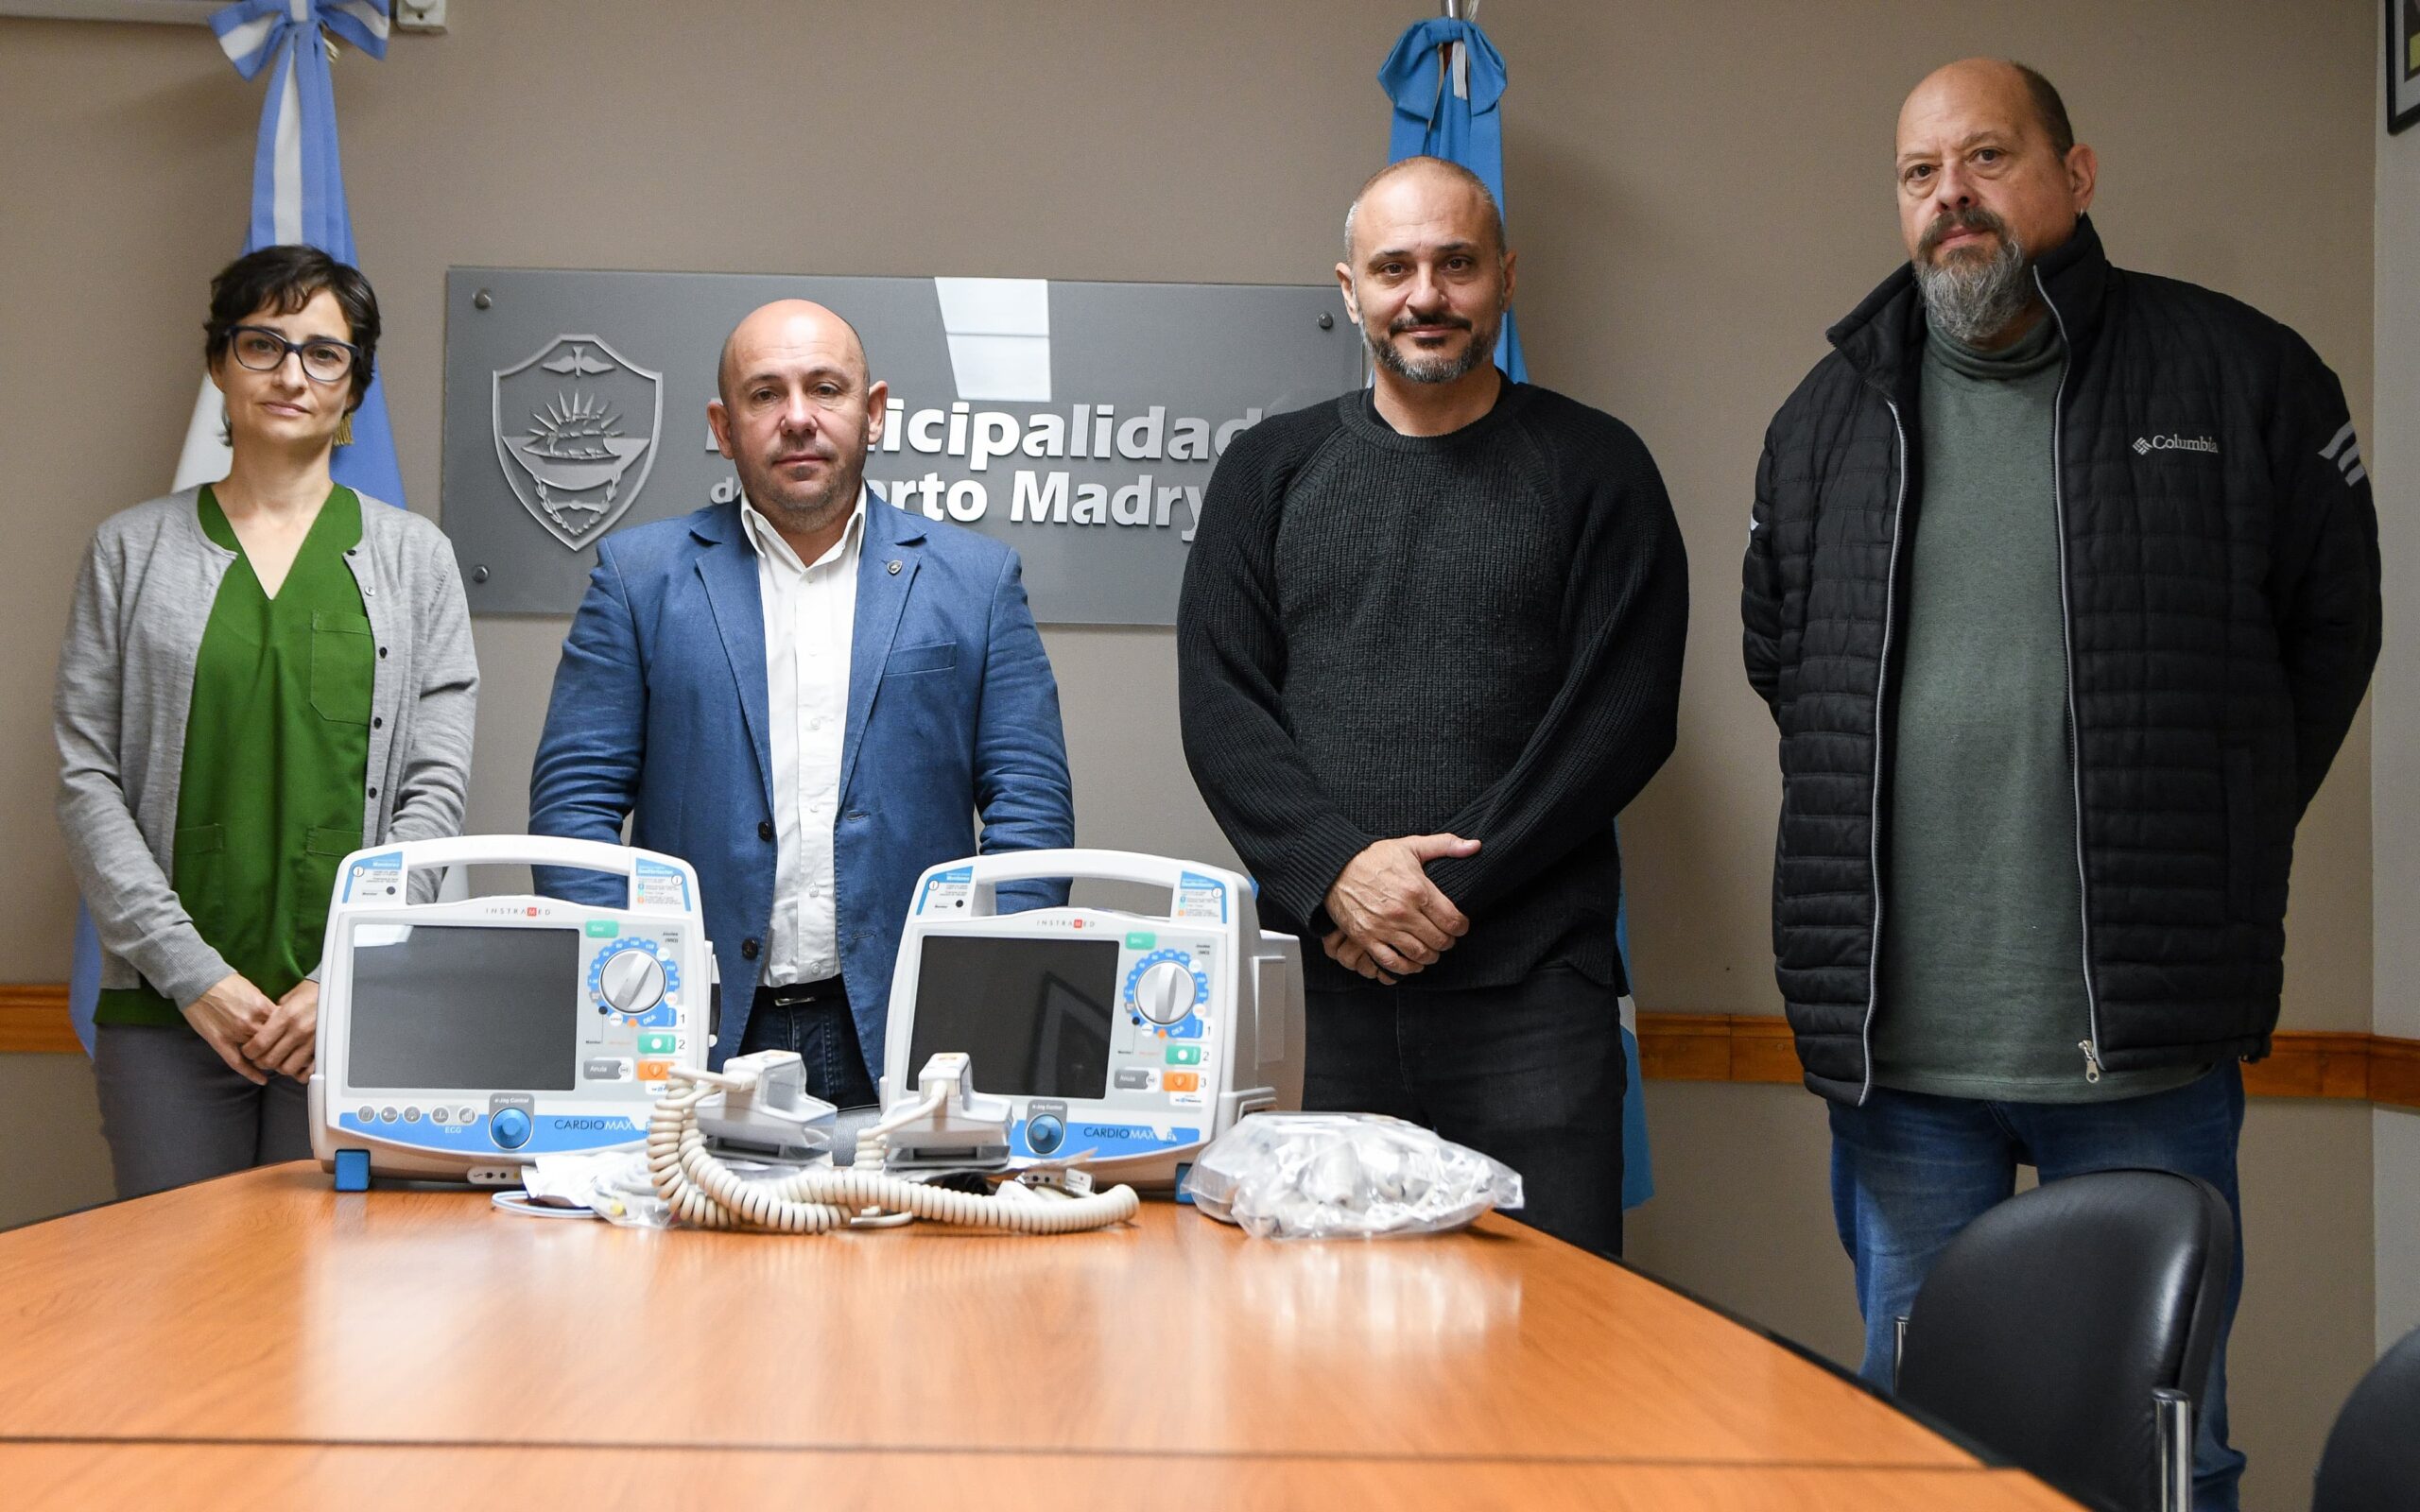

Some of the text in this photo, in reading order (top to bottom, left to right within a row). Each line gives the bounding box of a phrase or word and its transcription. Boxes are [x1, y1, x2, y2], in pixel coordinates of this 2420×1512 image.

[705, 398, 1263, 472] icipalidad
[2152, 434, 2219, 453] Columbia
[710, 470, 1203, 542] d rto Madry
[486, 907, 551, 917] INSTRAMED
[680, 1013, 685, 1024] 1
[679, 1040, 685, 1050] 2
[1202, 1051, 1210, 1061] 2
[1201, 1077, 1207, 1088] 3
[444, 1125, 462, 1134] ECG
[554, 1119, 631, 1131] CARDIOMAX
[1083, 1126, 1155, 1141] CARDIOMAX
